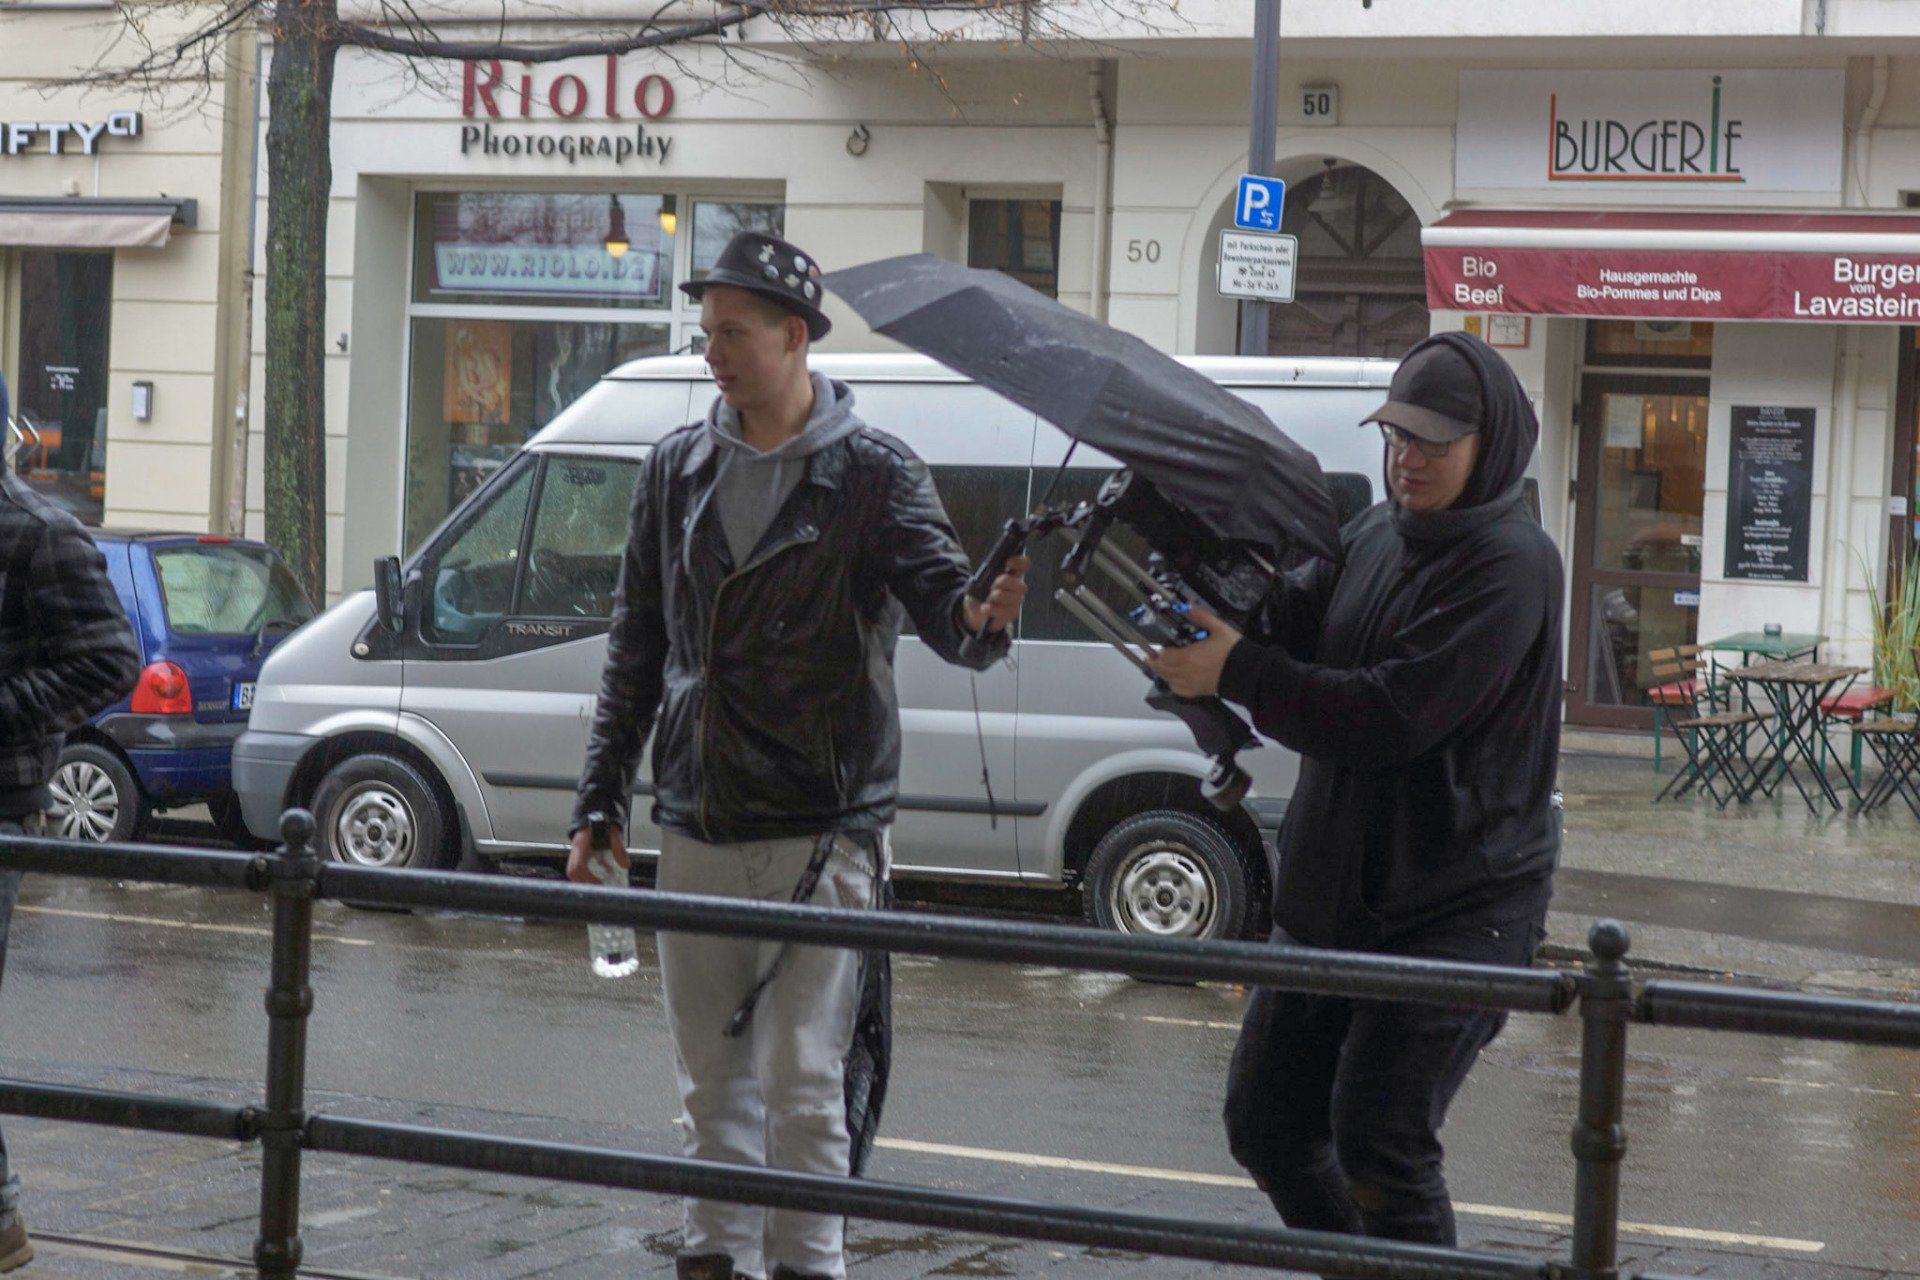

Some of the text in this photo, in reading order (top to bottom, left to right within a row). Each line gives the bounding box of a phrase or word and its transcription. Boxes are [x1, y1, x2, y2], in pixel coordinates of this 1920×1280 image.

[462, 54, 675, 119] Riolo
[1303, 93, 1330, 115] 50
[461, 122, 672, 164] Photography
[1242, 182, 1271, 223] P
[1127, 240, 1161, 264] 50
[1462, 256, 1498, 278] Bio
[1600, 268, 1698, 286] Hausgemachte
[1455, 283, 1503, 305] Beef
[1577, 286, 1722, 304] Bio-Pommes und Dips
[1849, 283, 1876, 295] vom
[505, 623, 573, 637] TRANSIT
